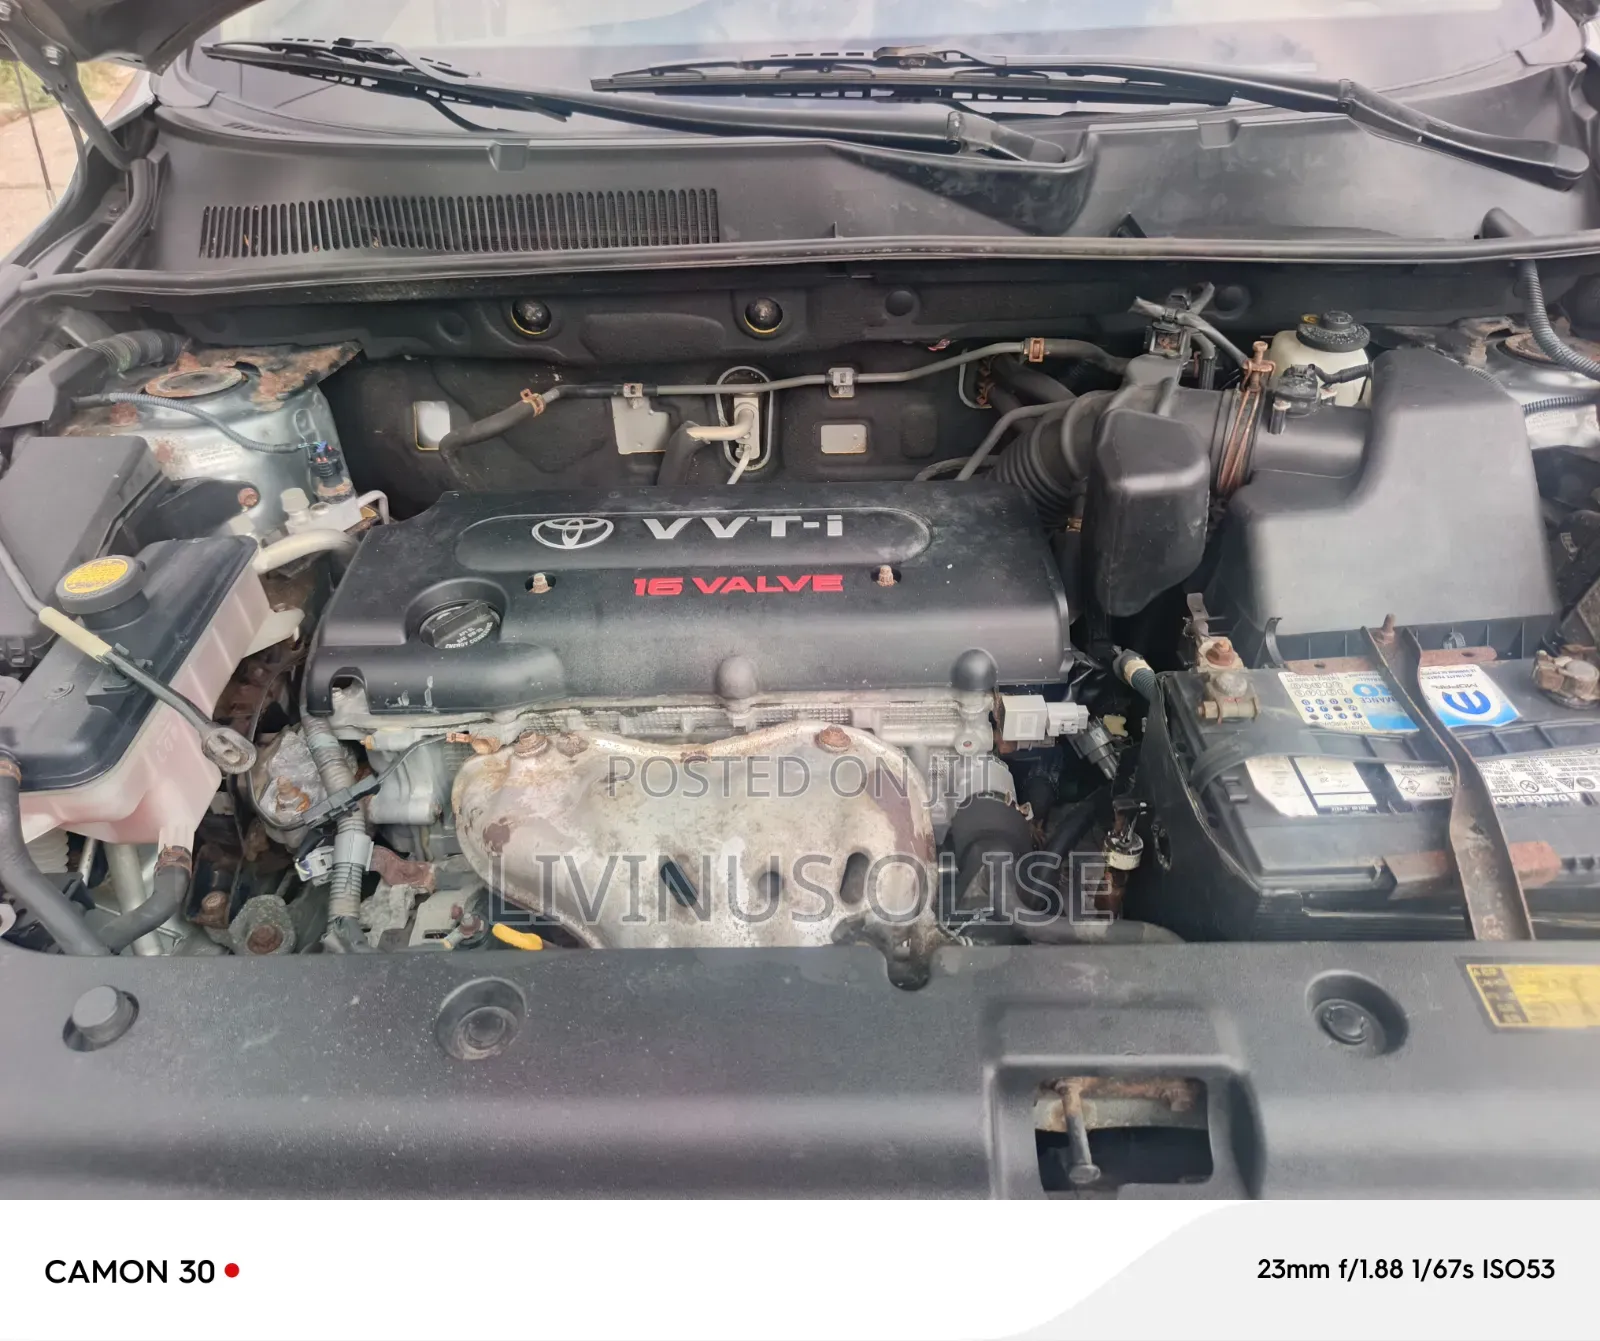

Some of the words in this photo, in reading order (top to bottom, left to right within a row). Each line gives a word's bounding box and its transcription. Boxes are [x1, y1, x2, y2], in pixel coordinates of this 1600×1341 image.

[642, 515, 843, 540] VVT-i
[633, 577, 684, 597] 16
[692, 575, 844, 594] VALVE
